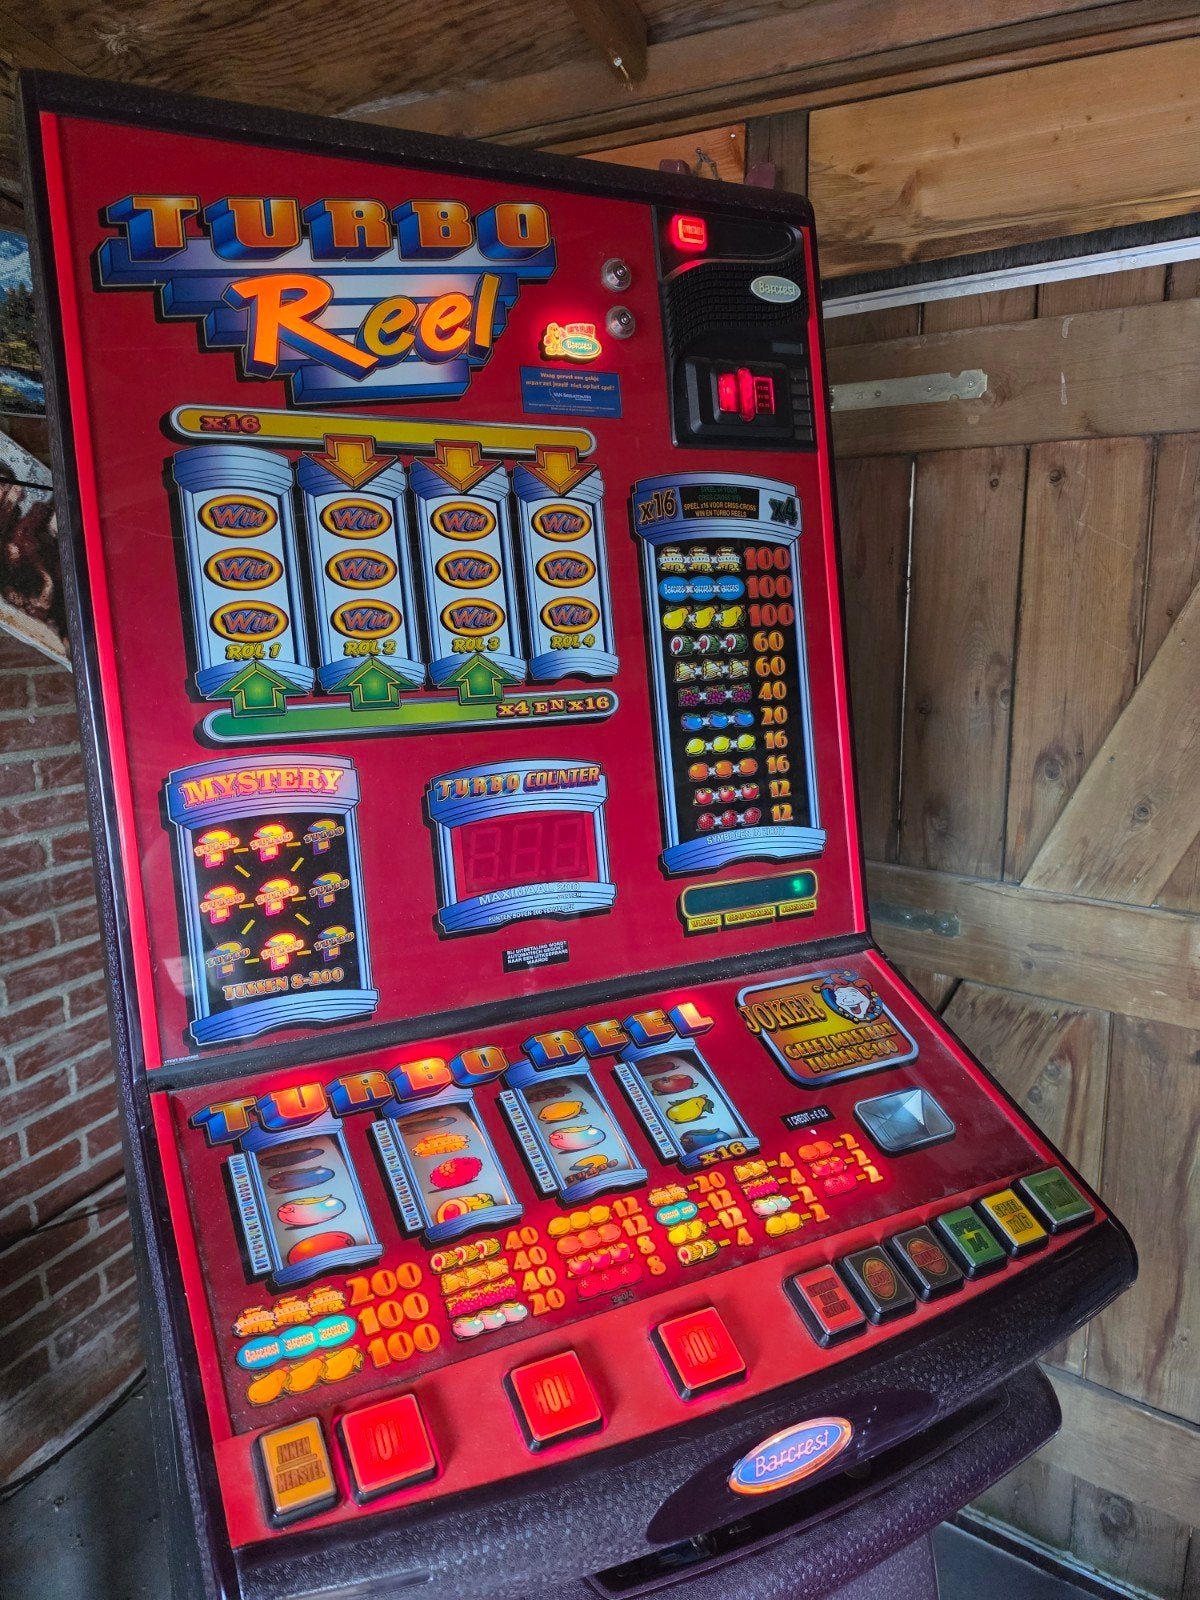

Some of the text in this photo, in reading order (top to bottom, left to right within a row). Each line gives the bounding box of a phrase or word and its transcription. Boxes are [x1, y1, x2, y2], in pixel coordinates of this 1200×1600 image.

[106, 195, 551, 262] TURBO
[758, 279, 796, 296] Barcrest
[223, 273, 501, 380] Reel
[199, 414, 261, 433] x16
[208, 503, 583, 534] Win Win Win Win
[638, 489, 678, 525] x16
[217, 556, 588, 582] Win Win Win Win
[744, 547, 790, 570] 100
[746, 575, 793, 599] 100
[223, 602, 592, 634] Win Win Win Win
[749, 603, 794, 627] 100
[226, 644, 280, 659] ROL 1
[343, 641, 396, 656] ROL 2
[452, 636, 501, 652] ROL 3
[550, 635, 597, 649] ROL 4
[753, 631, 784, 652] 60
[754, 655, 786, 677] 60
[758, 681, 787, 700] 40
[497, 696, 611, 717] x4 EN x16
[760, 705, 788, 725] 20
[764, 730, 788, 749] 16
[766, 754, 790, 774] 16
[180, 768, 344, 808] MYSTERY
[437, 766, 601, 801] TURBO COUNTER
[769, 779, 791, 797] 12
[771, 804, 793, 822] 12
[706, 830, 751, 845] SYMBOLEN
[479, 883, 580, 906] MAXIMAAL 200
[222, 967, 345, 1000] TUSSEN 8-200
[739, 994, 827, 1034] JOKER
[193, 1001, 713, 1145] TURBO REEL
[697, 1141, 748, 1167] x16
[779, 1151, 795, 1168] 4
[790, 1168, 806, 1185] 4
[612, 1196, 642, 1218] 12
[991, 1199, 1022, 1217] SPEEL
[622, 1214, 652, 1237] 12
[737, 1226, 754, 1246] 4
[505, 1226, 539, 1250] 40
[636, 1235, 656, 1255] 8
[513, 1245, 547, 1270] 40
[646, 1255, 666, 1275] 8
[345, 1262, 423, 1307] 200
[522, 1265, 556, 1291] 40
[528, 1287, 566, 1317] 20
[244, 1341, 280, 1363] Barcrest
[283, 1331, 315, 1351] arcrest
[319, 1321, 350, 1341] arcrest
[357, 1291, 430, 1336] 100
[367, 1322, 441, 1368] 100
[754, 1428, 829, 1478] Barcrest
